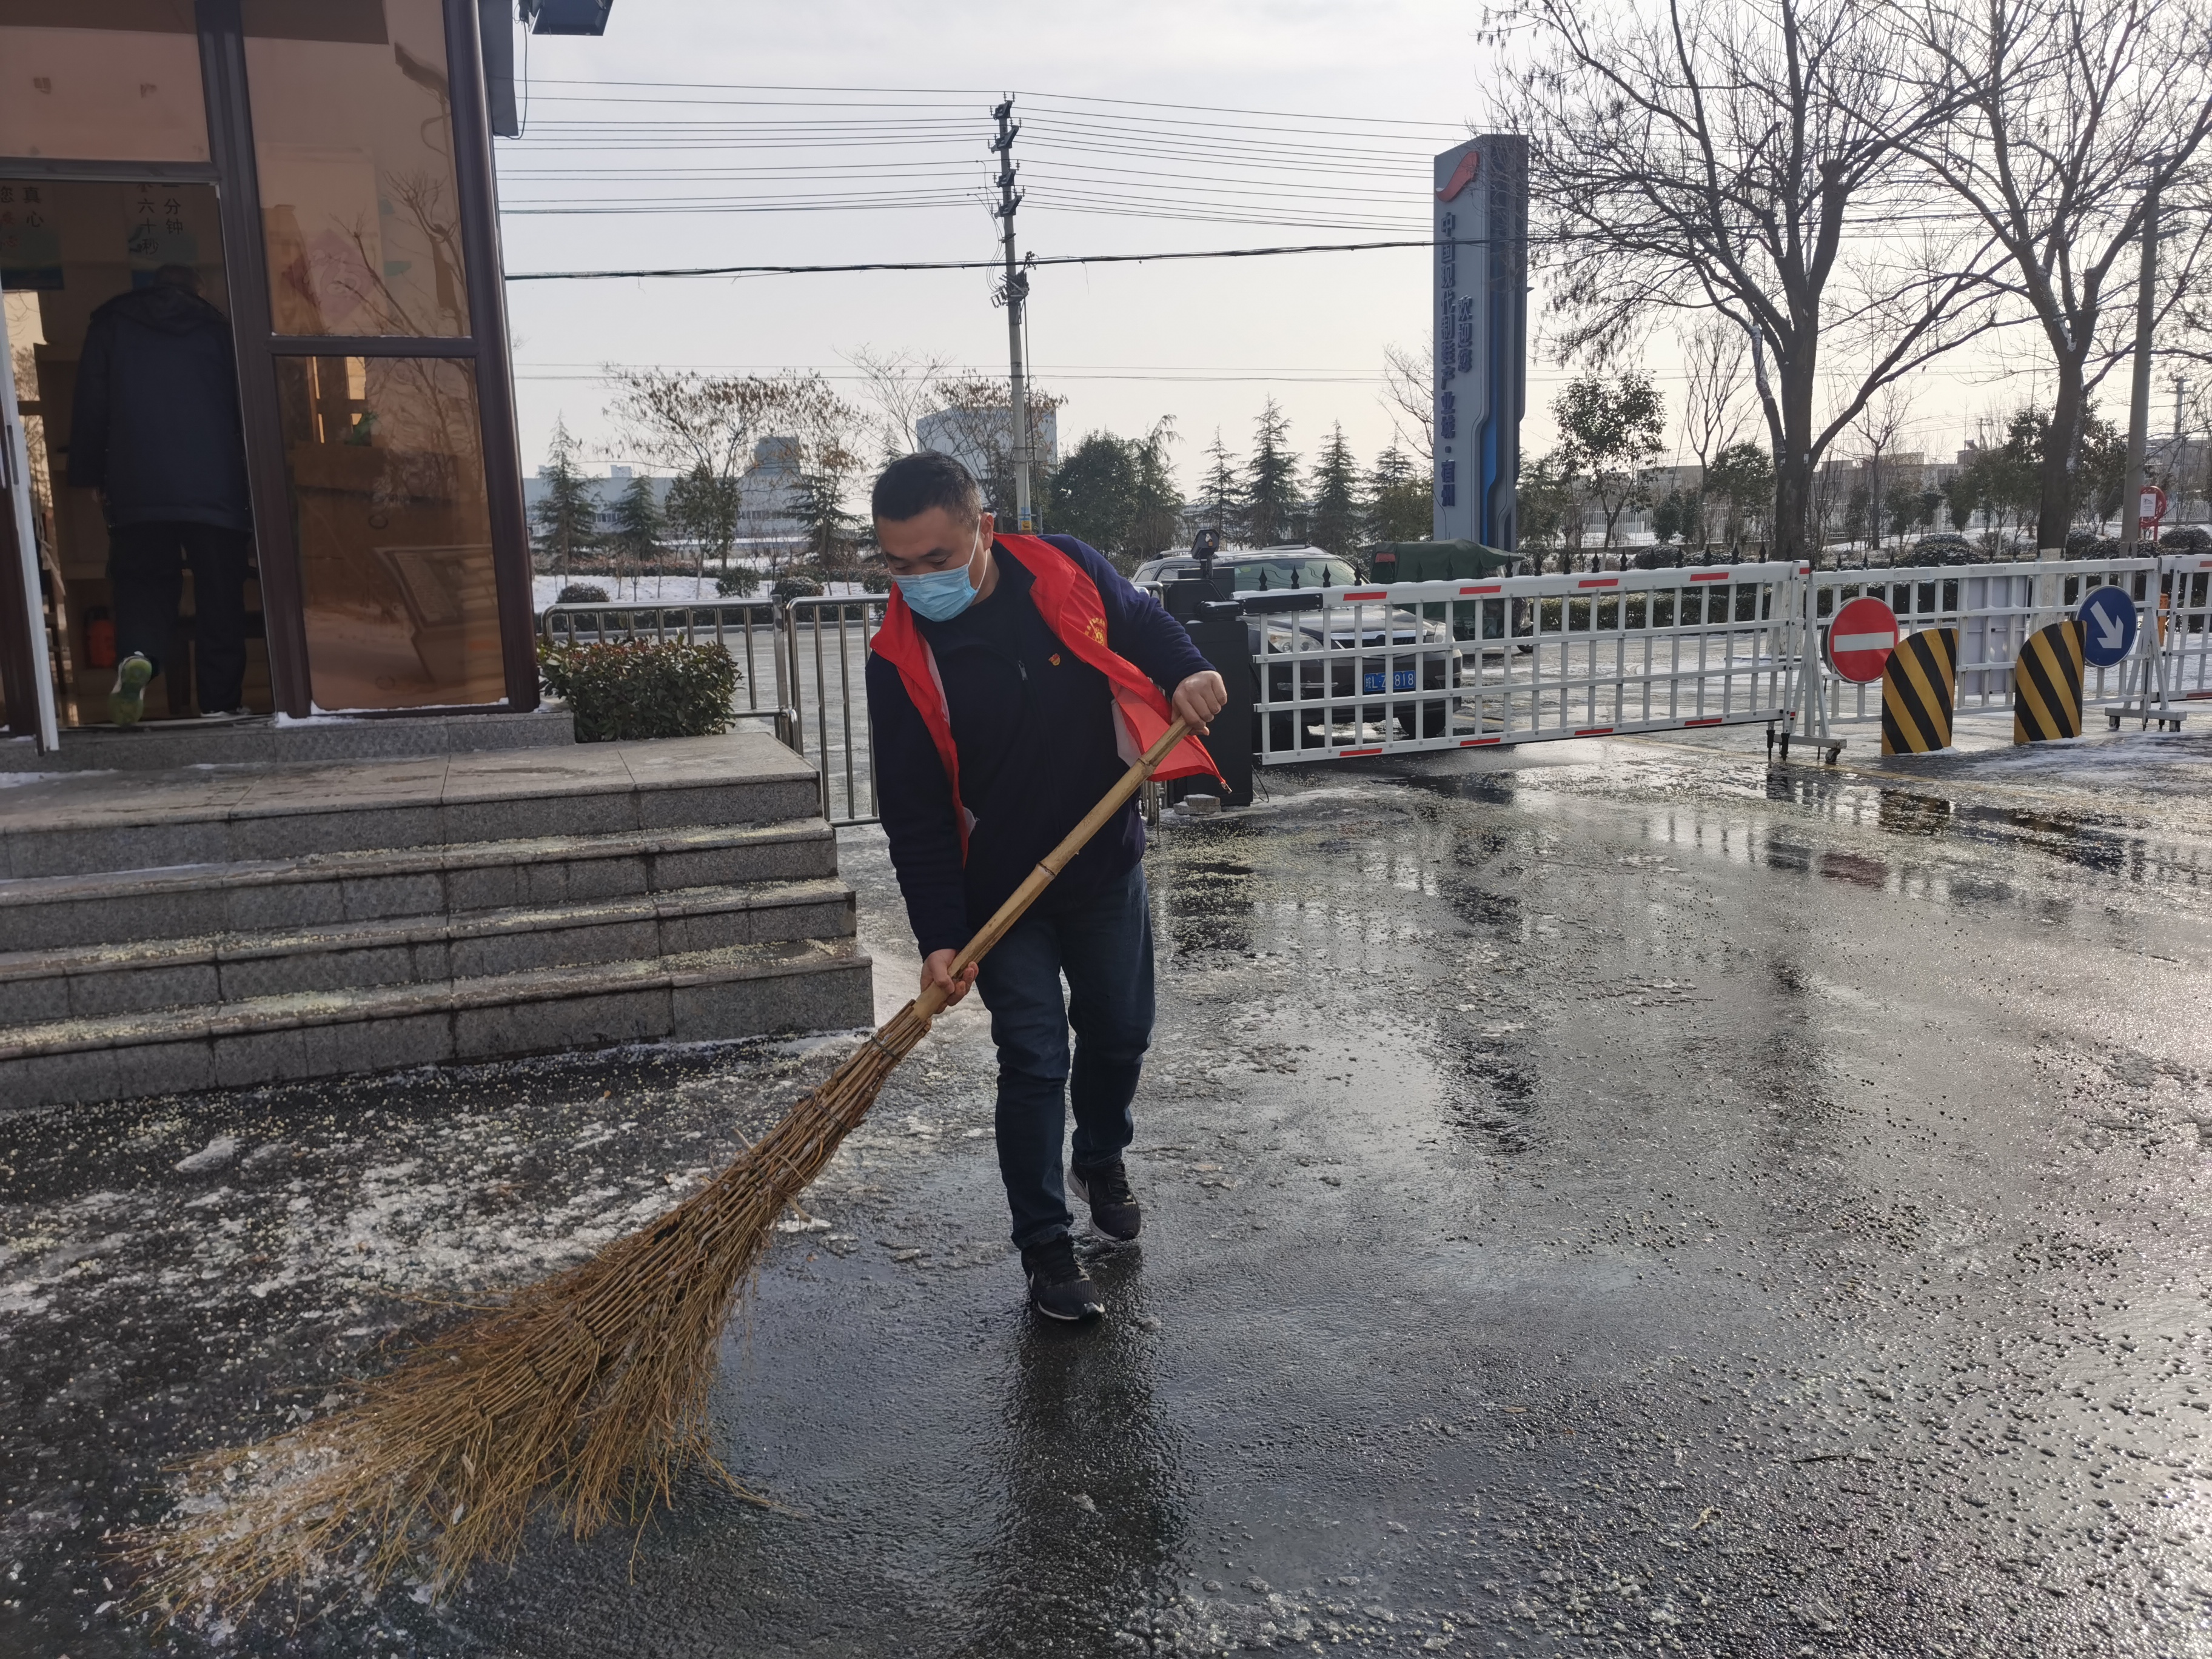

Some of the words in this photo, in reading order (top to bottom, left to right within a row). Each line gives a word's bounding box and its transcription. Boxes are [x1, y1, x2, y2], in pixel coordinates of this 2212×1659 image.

[22, 186, 44, 227] 真心
[1458, 295, 1473, 373] 欢迎您
[1366, 673, 1414, 689] 皖L·Z818
